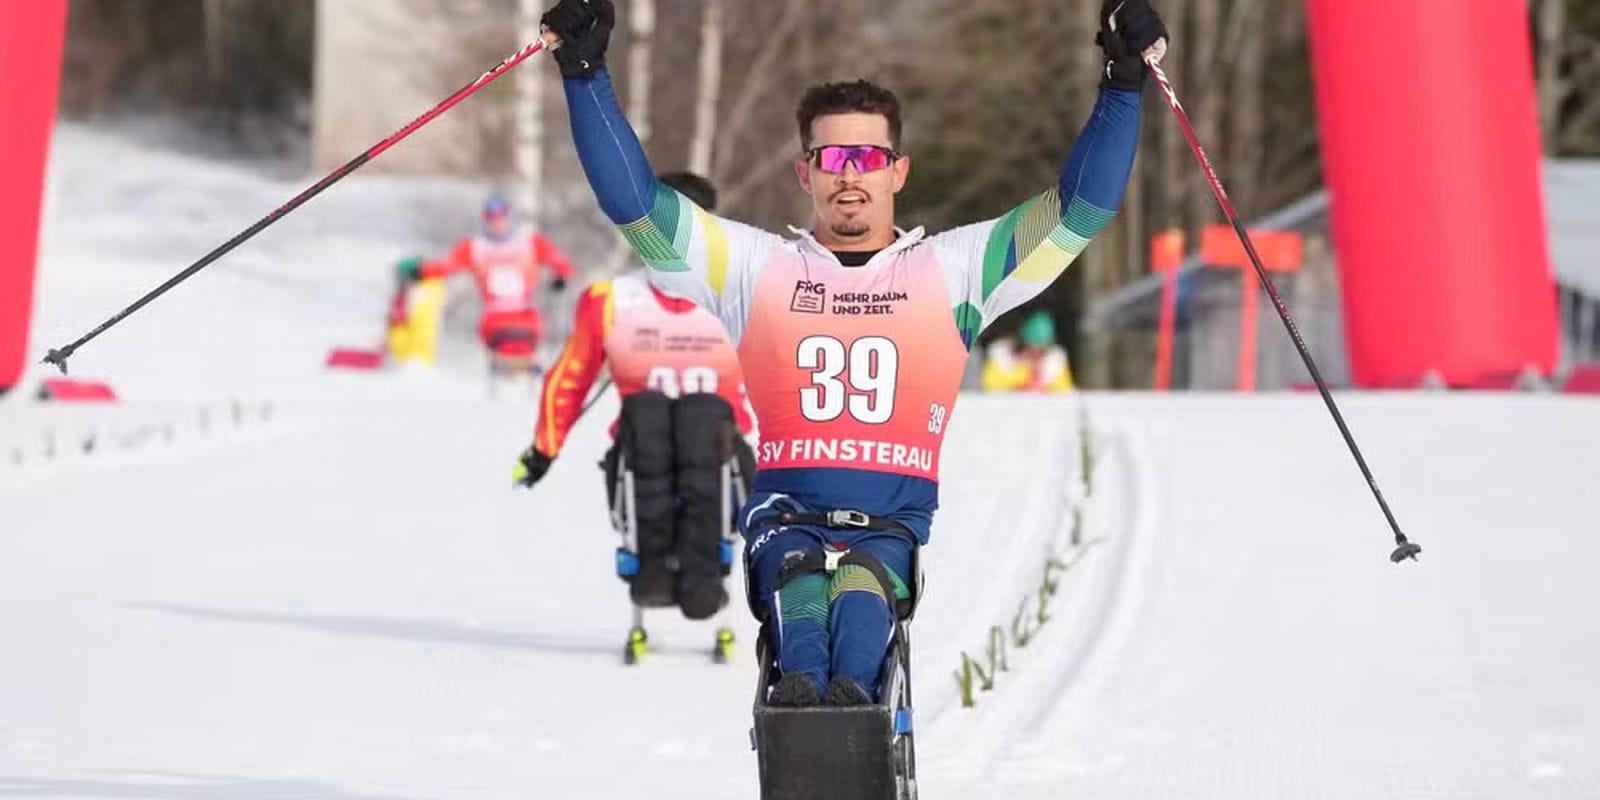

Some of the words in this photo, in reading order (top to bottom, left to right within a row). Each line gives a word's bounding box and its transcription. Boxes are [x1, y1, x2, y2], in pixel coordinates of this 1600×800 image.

[796, 280, 825, 295] FRG
[833, 292, 869, 303] MEHR
[832, 305, 861, 315] UND
[864, 305, 893, 315] ZEIT.
[797, 334, 899, 425] 39
[928, 402, 946, 434] 39
[790, 438, 932, 471] FINSTERAU
